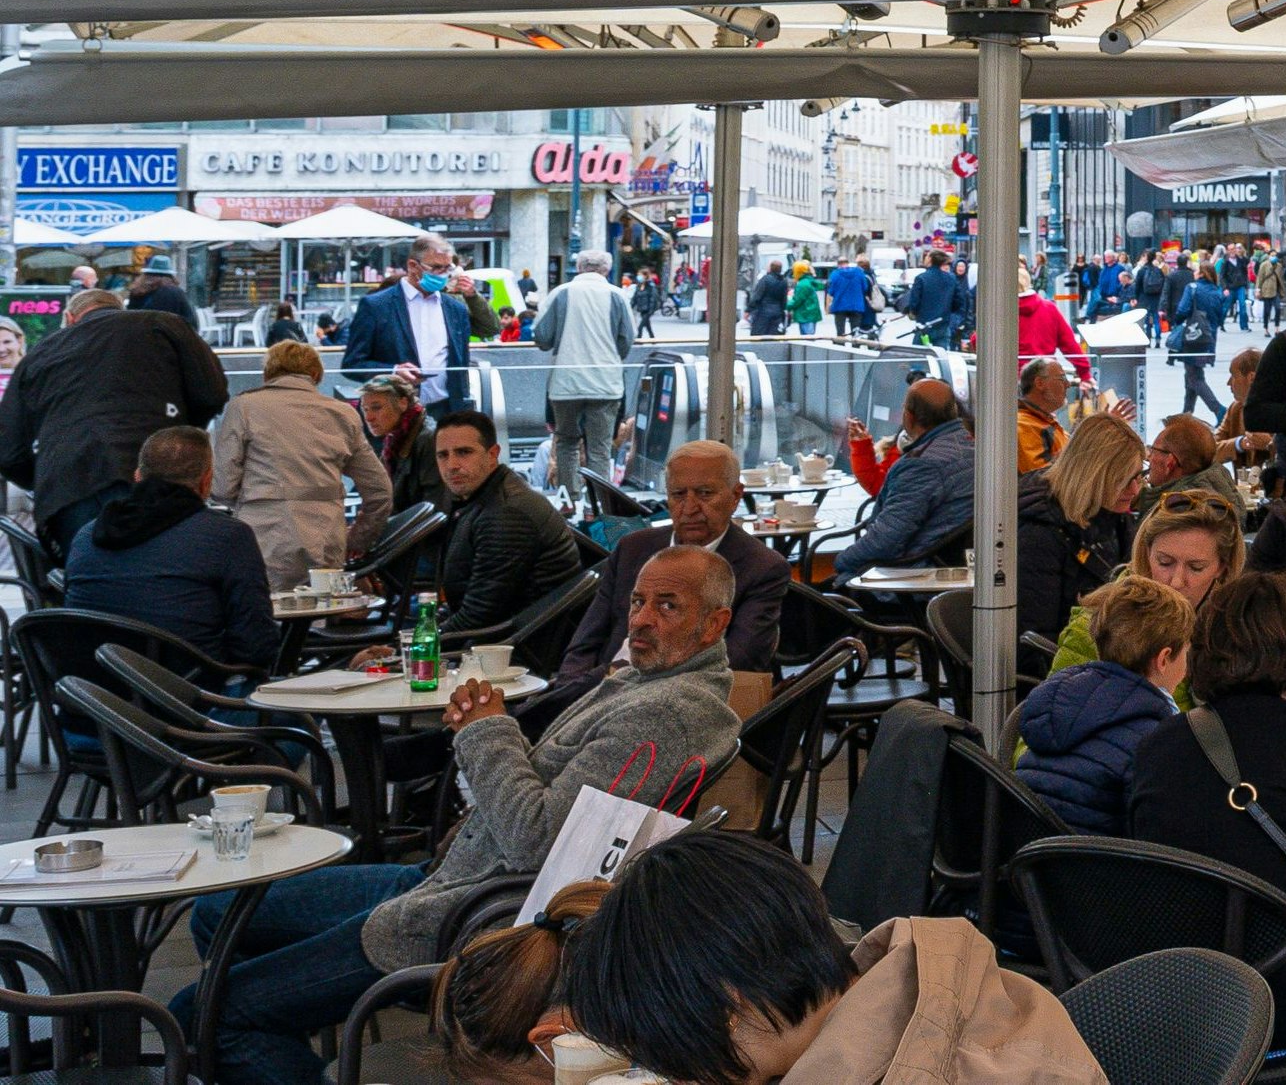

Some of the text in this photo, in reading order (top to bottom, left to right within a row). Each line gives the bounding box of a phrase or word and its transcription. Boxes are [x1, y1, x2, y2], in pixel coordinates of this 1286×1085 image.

[296, 151, 501, 173] KONDITOREI
[35, 155, 178, 185] EXCHANGE
[1172, 184, 1258, 203] HUMANIC
[226, 197, 325, 209] DAS BESTE EIS
[374, 197, 398, 207] THE
[423, 206, 467, 216] CREAM
[9, 299, 61, 314] neos
